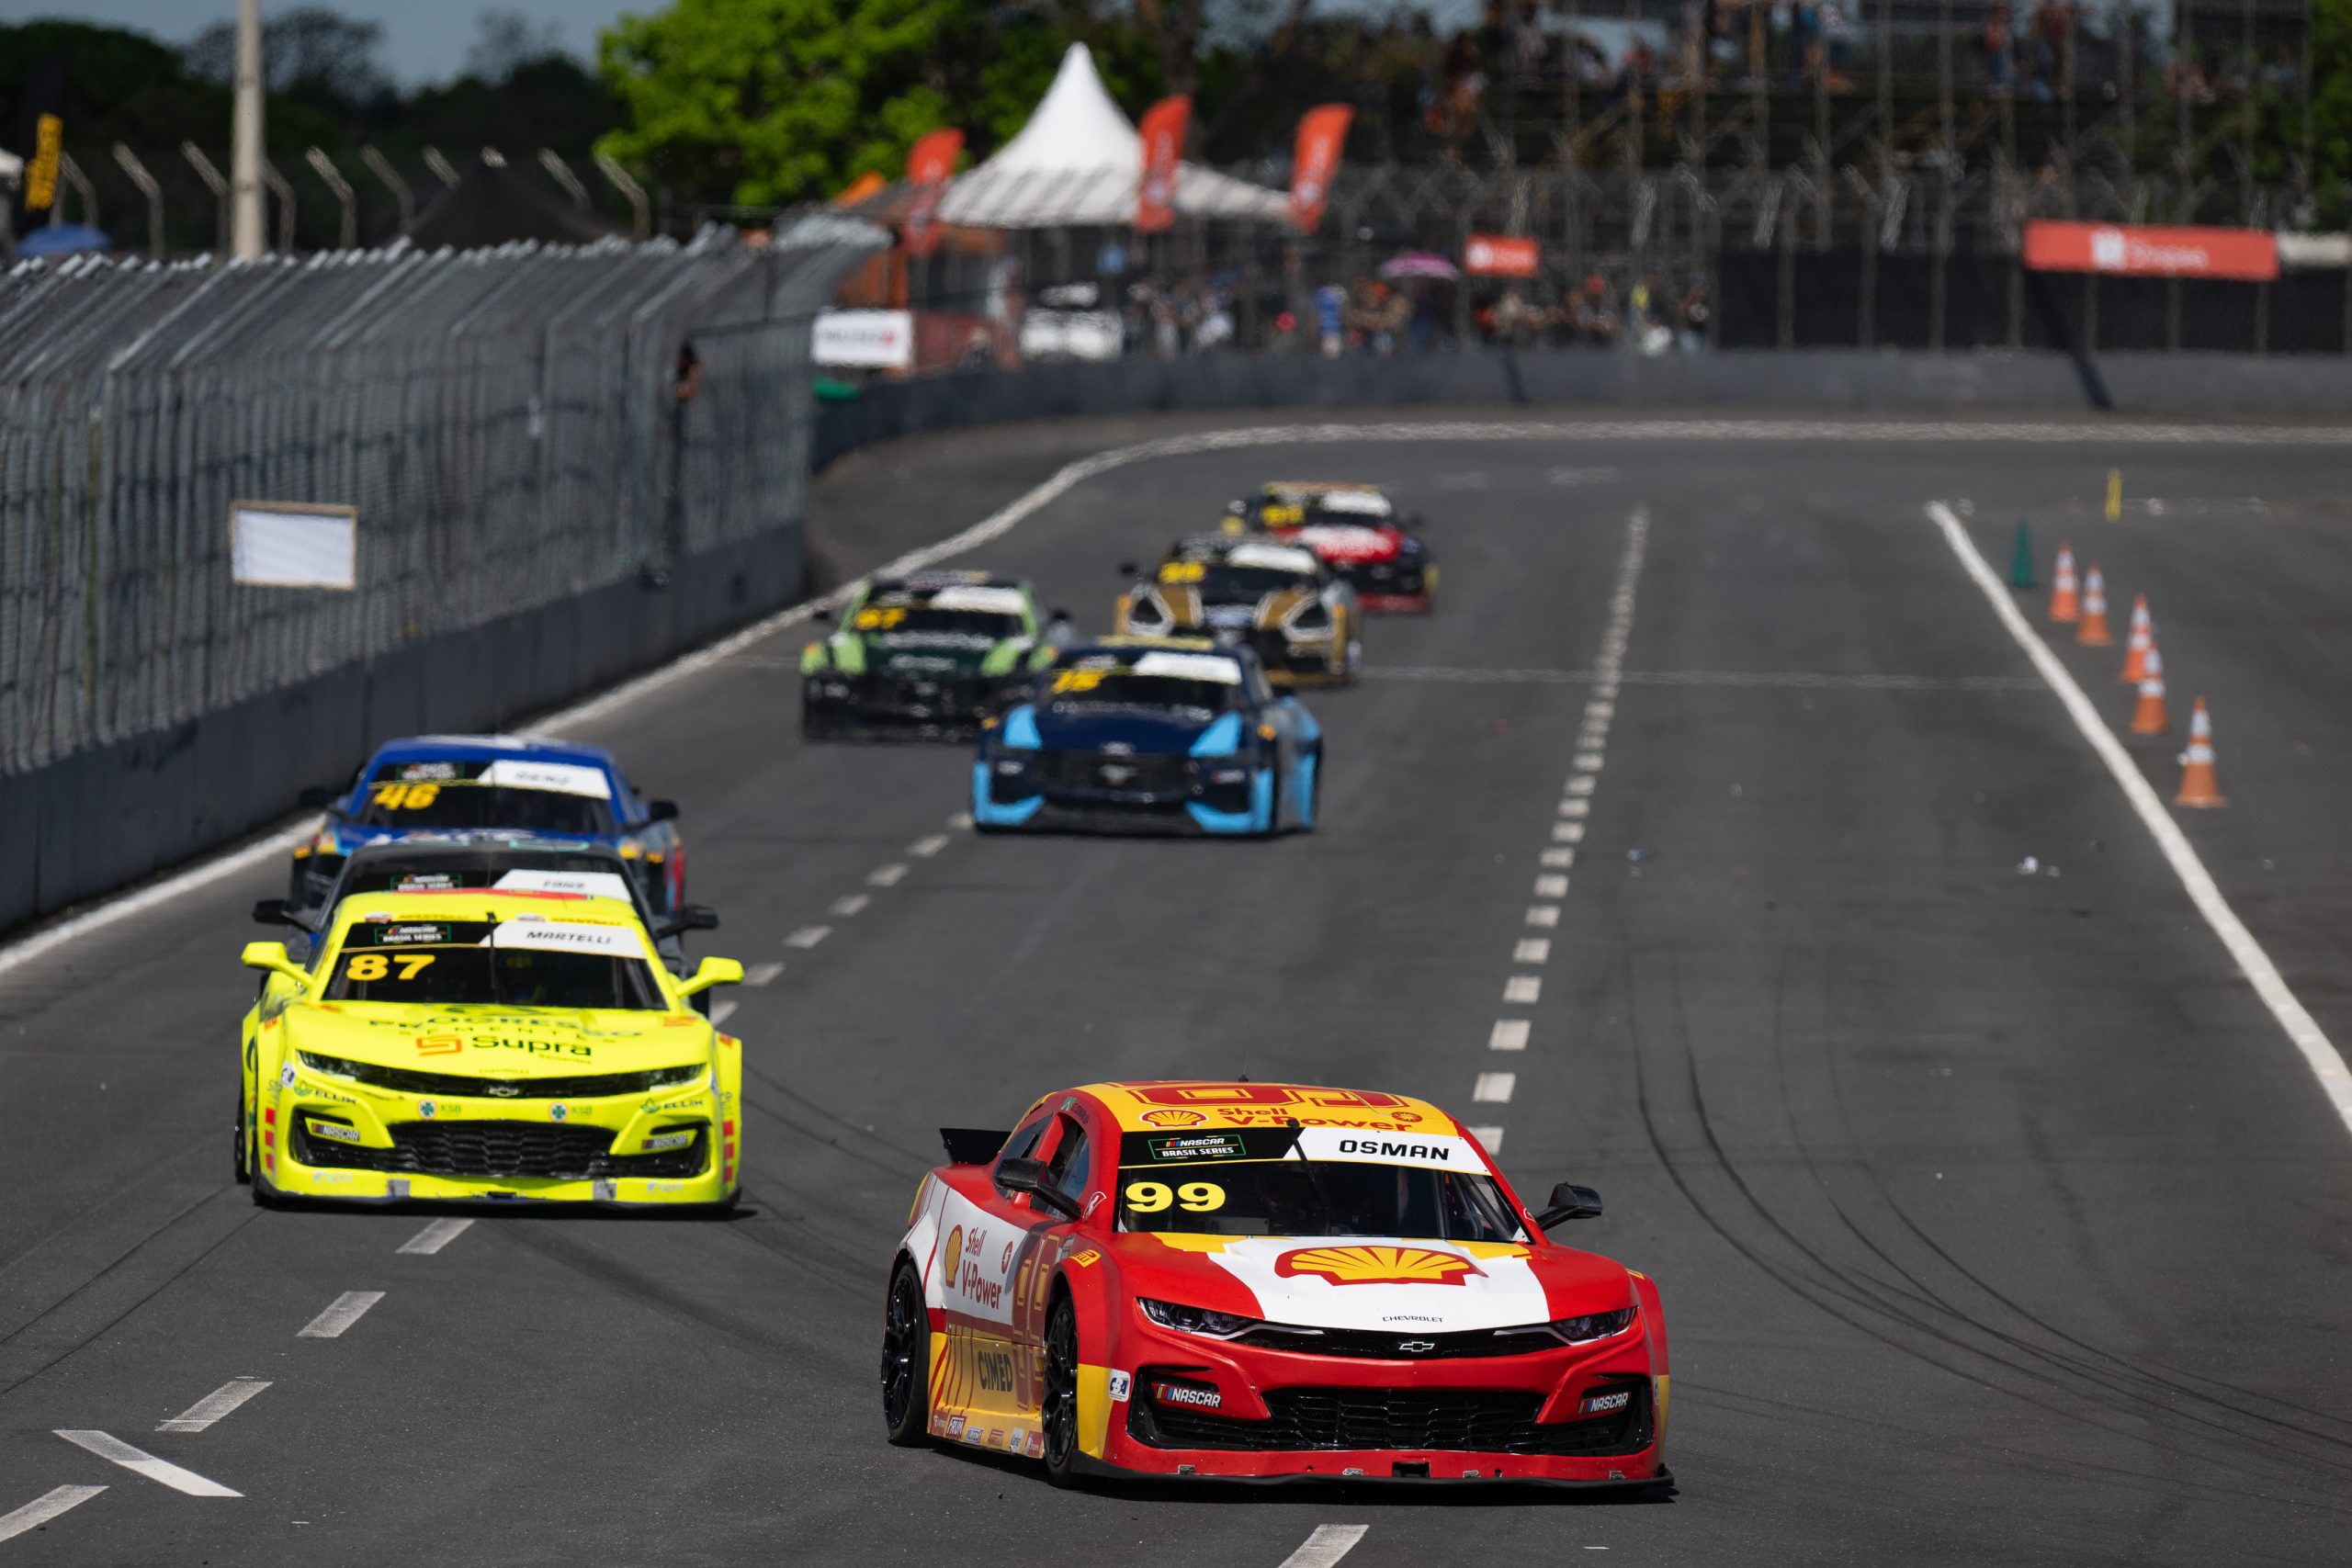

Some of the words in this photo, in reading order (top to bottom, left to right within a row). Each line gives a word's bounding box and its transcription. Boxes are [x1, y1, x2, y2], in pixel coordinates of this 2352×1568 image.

[374, 784, 441, 810] 46
[526, 931, 612, 944] MARTELLI
[346, 953, 436, 981] 87
[471, 1035, 592, 1057] Supra
[1217, 1108, 1288, 1116] Shell
[322, 1123, 360, 1142] NASCAR
[1223, 1115, 1413, 1133] V-Power
[1161, 1148, 1198, 1157] BRASIL
[1200, 1146, 1235, 1156] SERIES
[1180, 1137, 1226, 1147] NASCAR
[1339, 1139, 1450, 1160] OSMAN
[1125, 1181, 1226, 1213] 99
[965, 1227, 988, 1258] Shell
[962, 1259, 1002, 1310] V-Power
[978, 1350, 1013, 1393] CIMED
[1171, 1388, 1222, 1408] NASCAR
[1590, 1392, 1629, 1412] NASCAR
